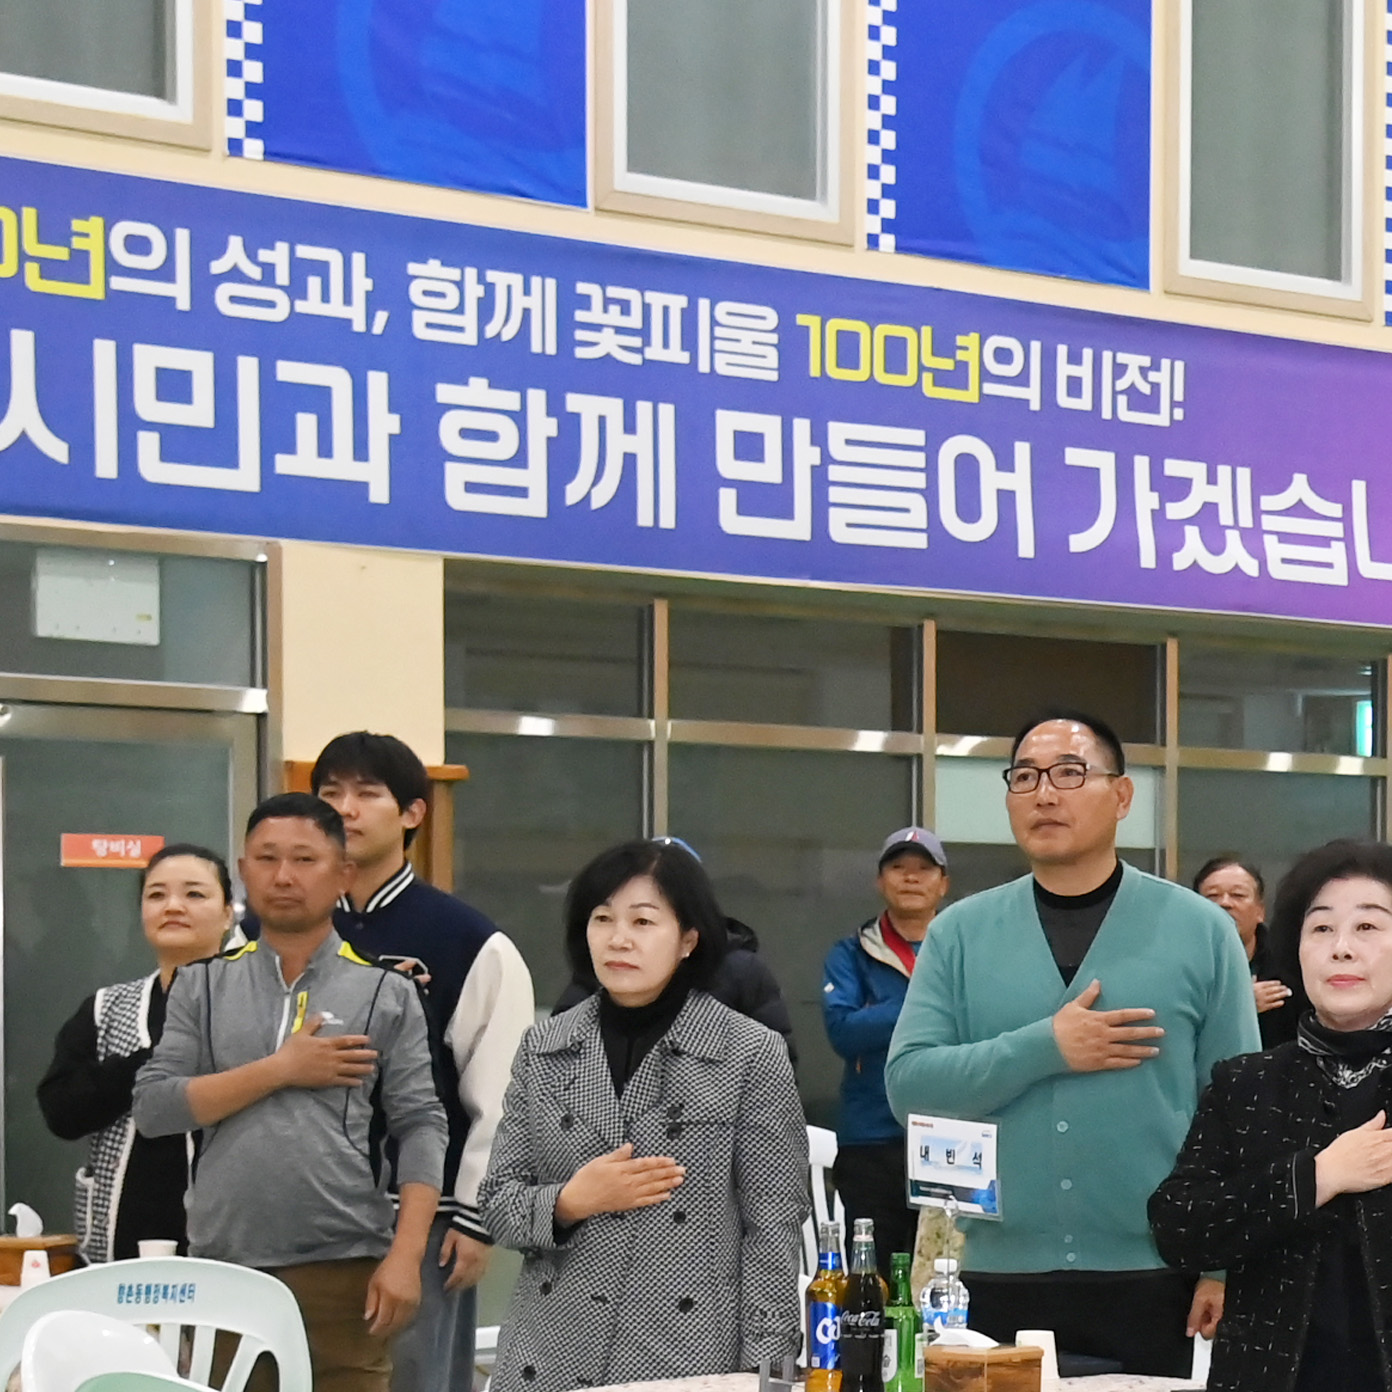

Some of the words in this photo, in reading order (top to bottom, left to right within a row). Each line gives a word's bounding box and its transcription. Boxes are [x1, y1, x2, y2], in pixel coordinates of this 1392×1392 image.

[209, 235, 390, 335] 성과,
[407, 258, 558, 355] 함께
[574, 280, 780, 382] 꽃피울
[795, 313, 1041, 410] 100년의
[1056, 343, 1185, 427] 비전!
[0, 328, 402, 504] 시민과
[434, 376, 678, 529] 함께
[714, 409, 1035, 559] 만들어
